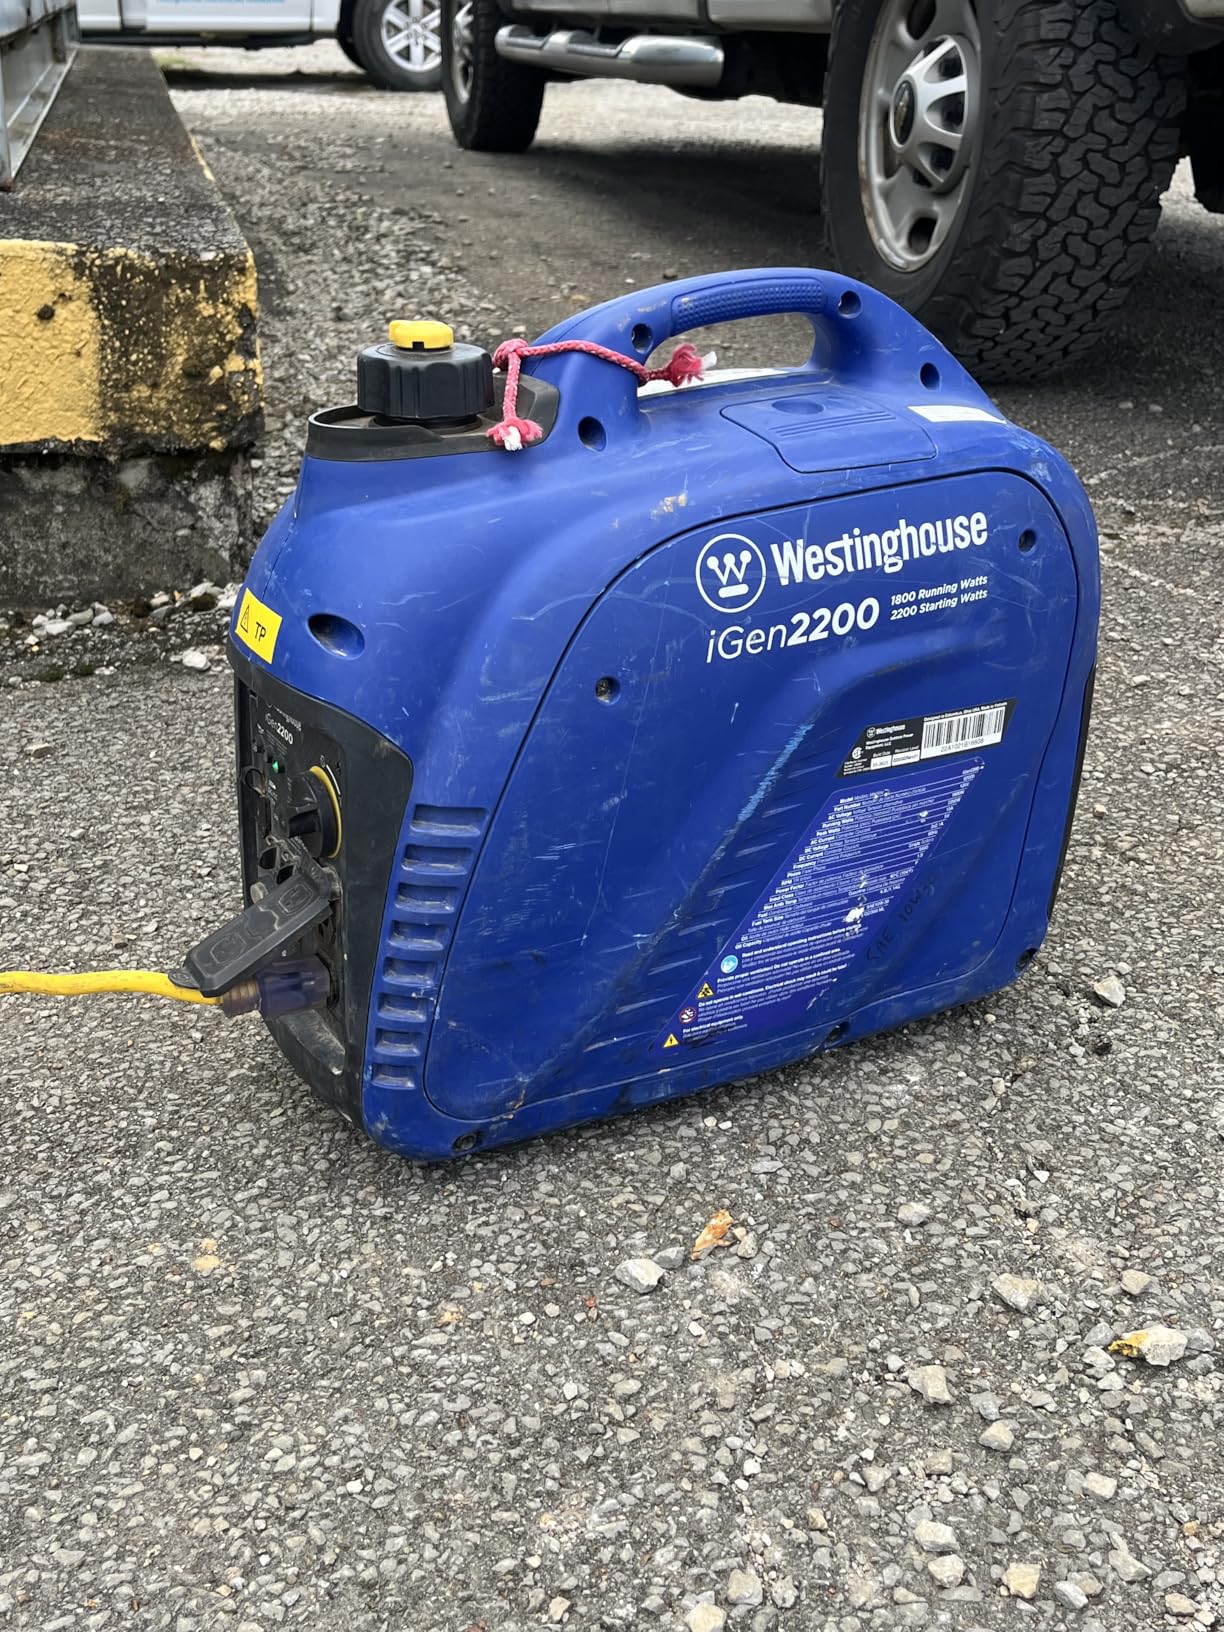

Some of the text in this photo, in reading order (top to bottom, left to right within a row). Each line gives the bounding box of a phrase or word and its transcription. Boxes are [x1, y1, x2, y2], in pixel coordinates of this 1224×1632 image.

[769, 511, 988, 585] Westinghouse
[890, 575, 988, 605] 1800 Running Watts
[890, 589, 988, 620] 2200 Starting Watts
[254, 620, 266, 641] TP
[706, 597, 880, 663] iGen2200
